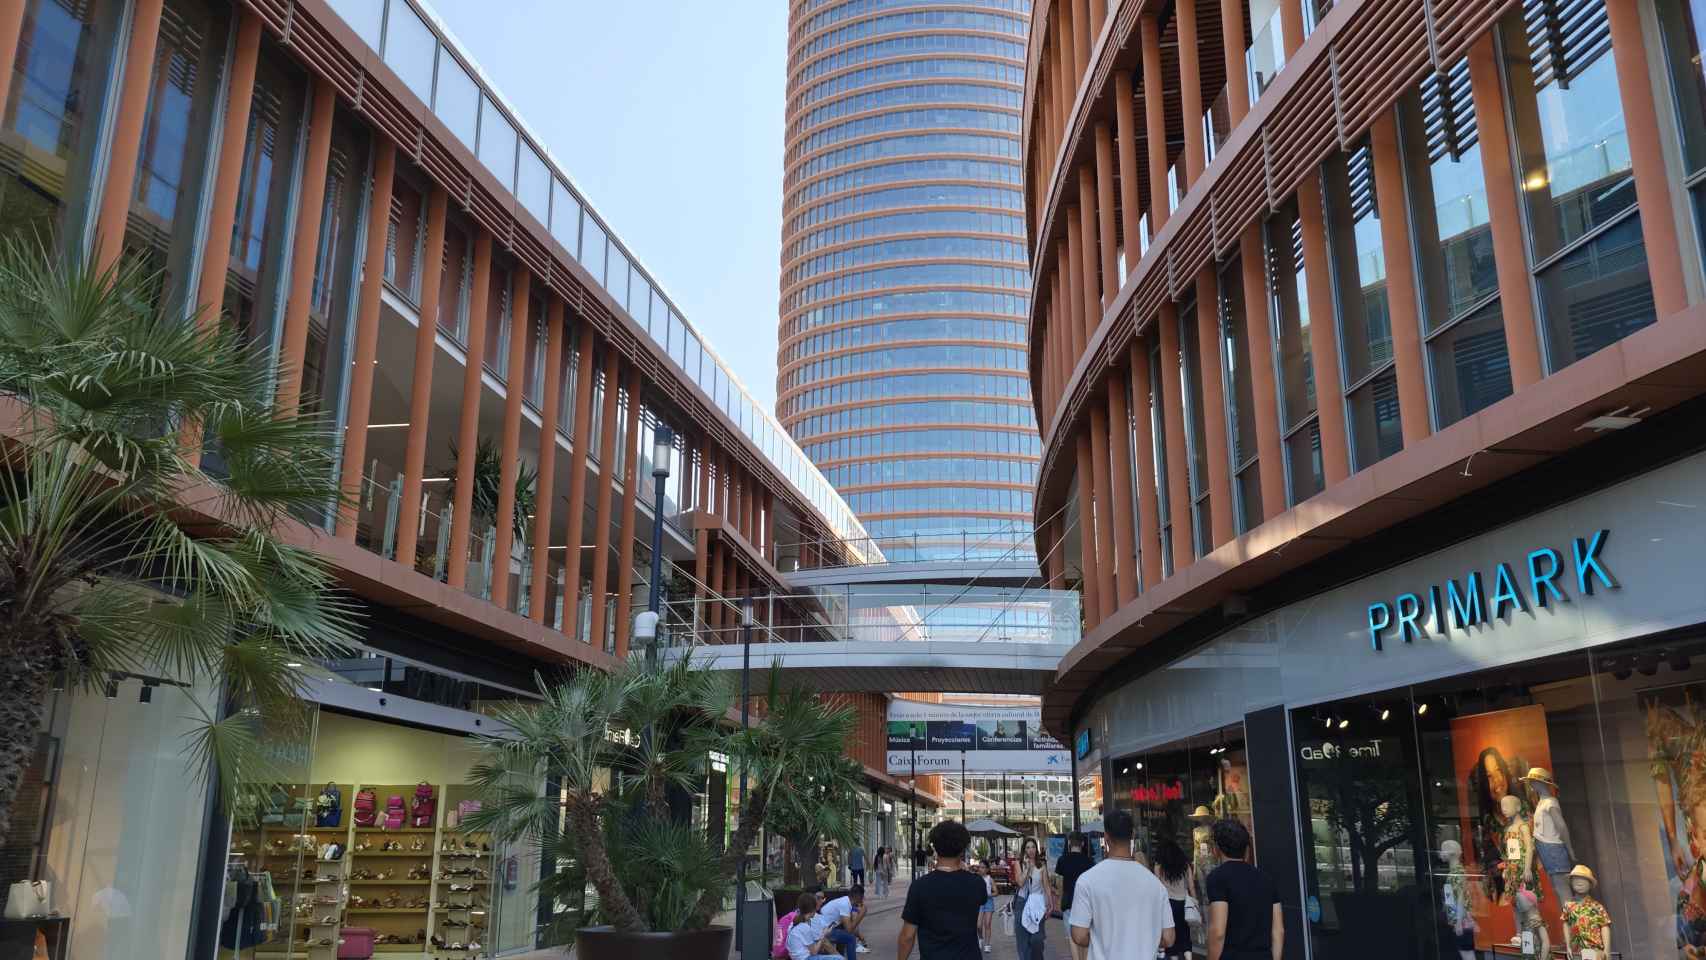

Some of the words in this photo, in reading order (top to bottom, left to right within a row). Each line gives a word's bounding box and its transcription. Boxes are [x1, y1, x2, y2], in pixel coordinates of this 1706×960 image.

[1367, 529, 1619, 651] PRIMARK
[931, 736, 971, 745] Proyecciones
[982, 736, 1023, 744] Conferencias
